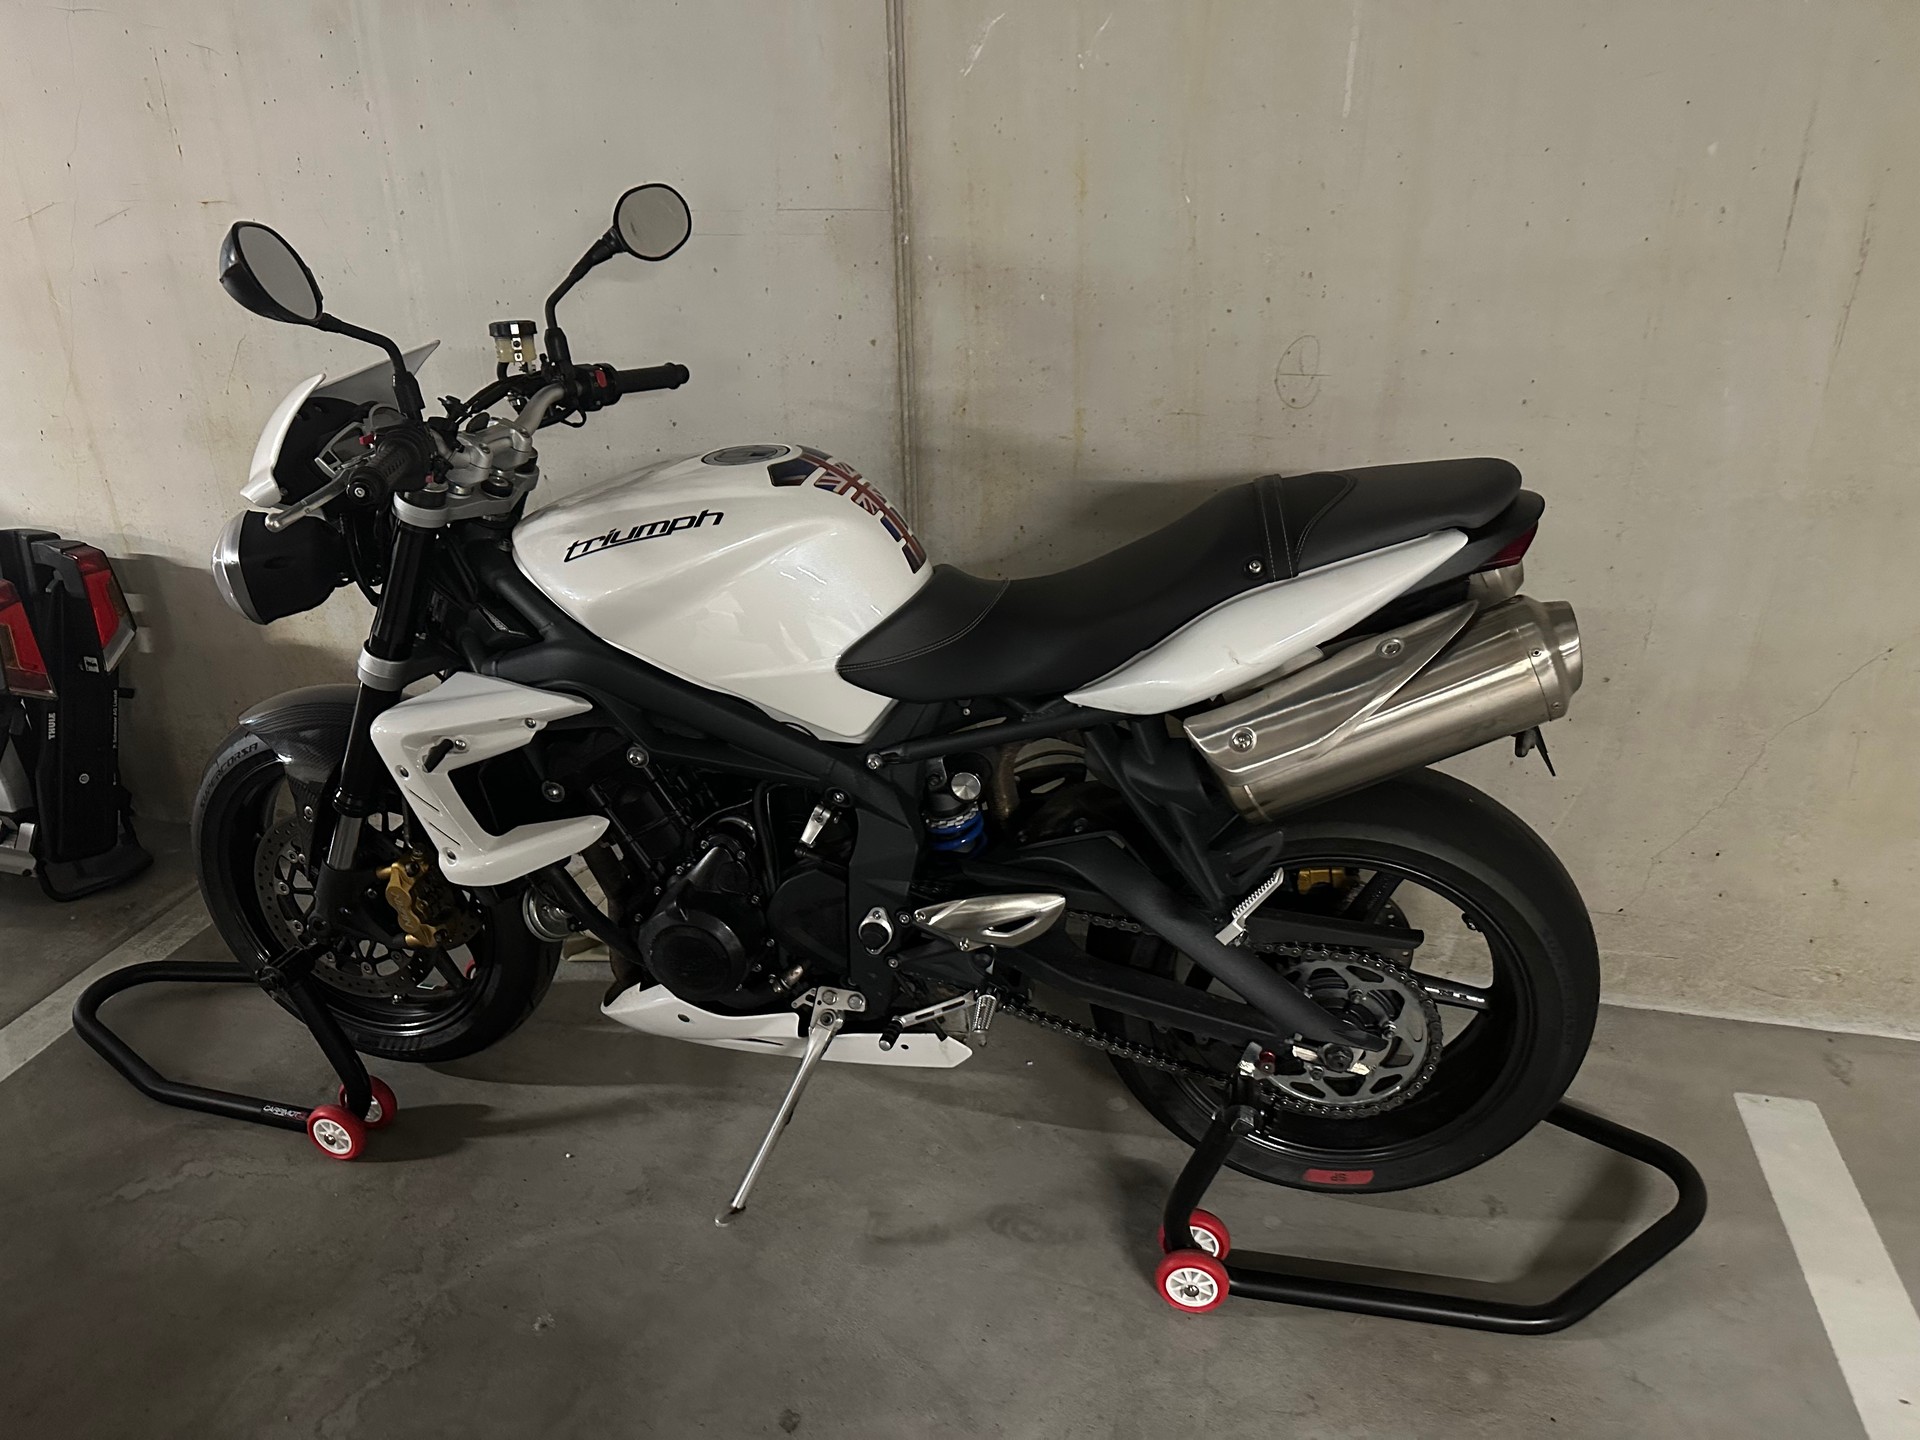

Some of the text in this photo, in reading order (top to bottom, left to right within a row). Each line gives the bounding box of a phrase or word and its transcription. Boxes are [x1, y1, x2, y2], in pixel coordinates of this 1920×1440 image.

[564, 509, 725, 563] triumph
[48, 713, 56, 740] THULE
[200, 742, 259, 809] SUPERCORSA
